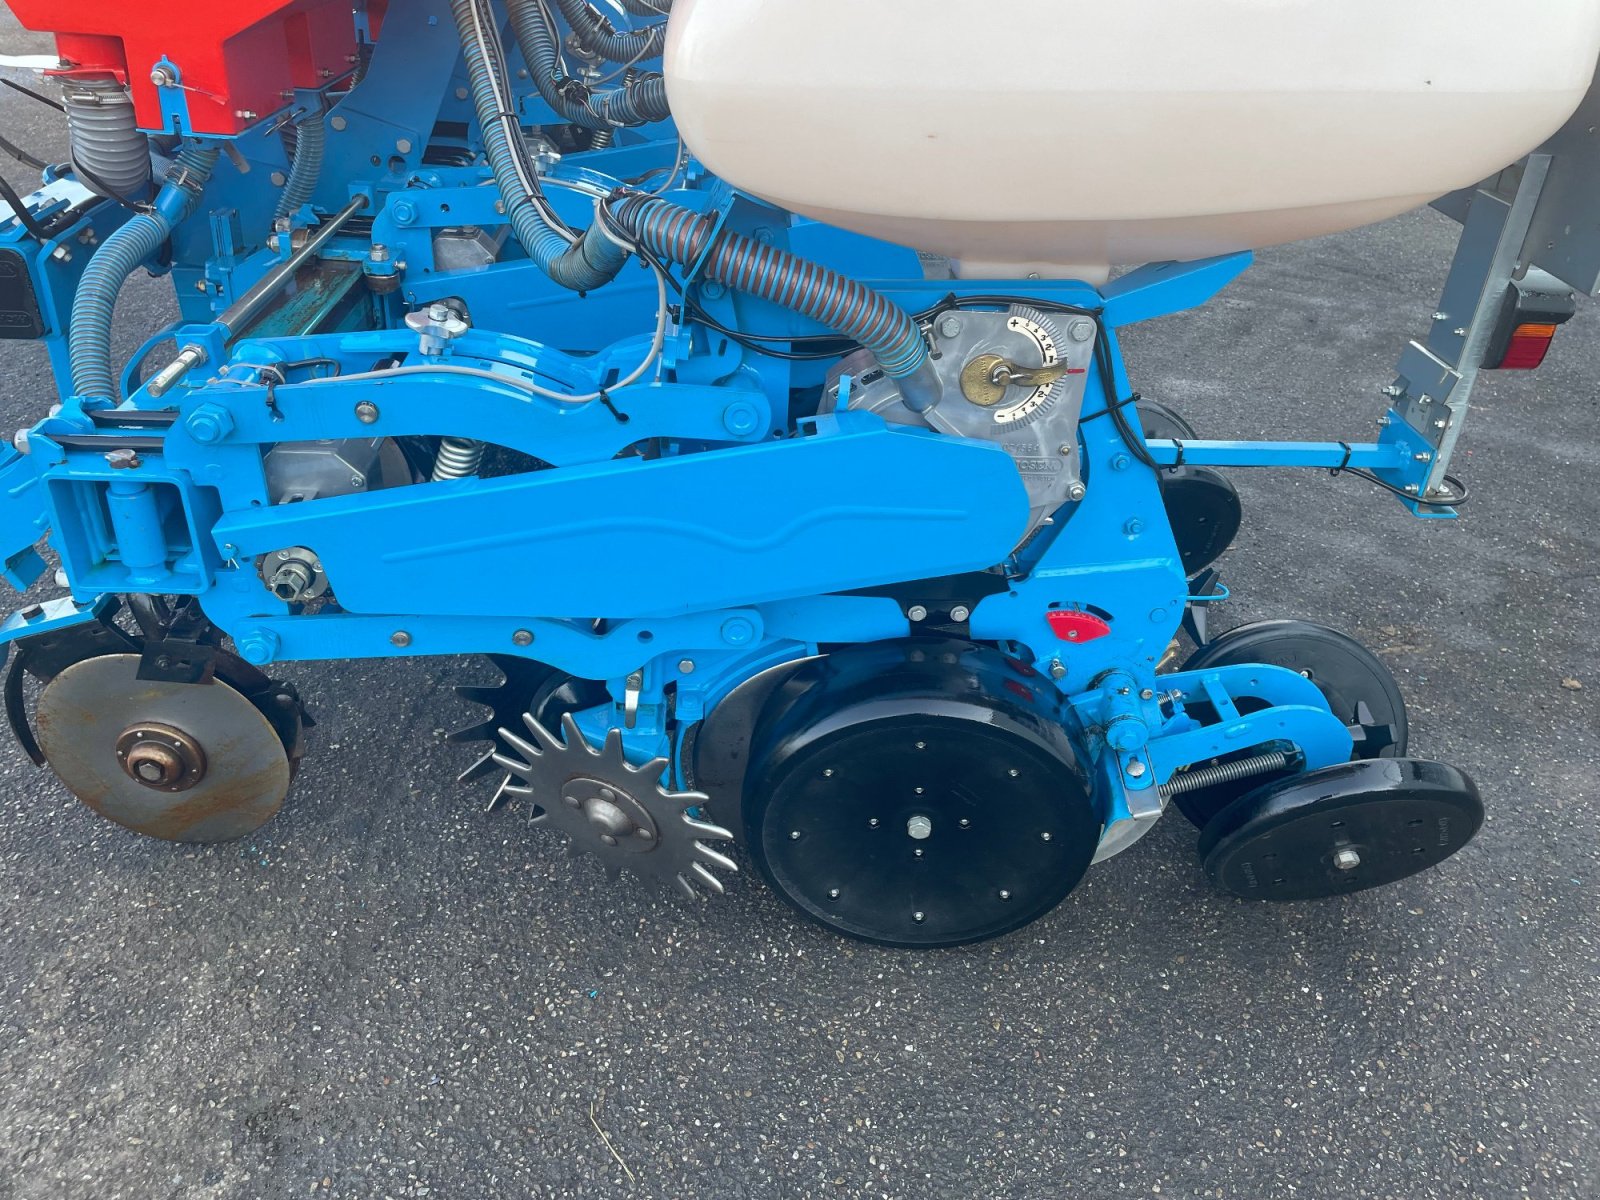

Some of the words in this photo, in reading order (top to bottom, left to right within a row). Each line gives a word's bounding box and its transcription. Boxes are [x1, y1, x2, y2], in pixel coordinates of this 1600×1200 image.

[1040, 334, 1047, 342] 3
[1045, 343, 1052, 351] 2
[1048, 355, 1054, 364] 1
[1037, 390, 1045, 398] 2
